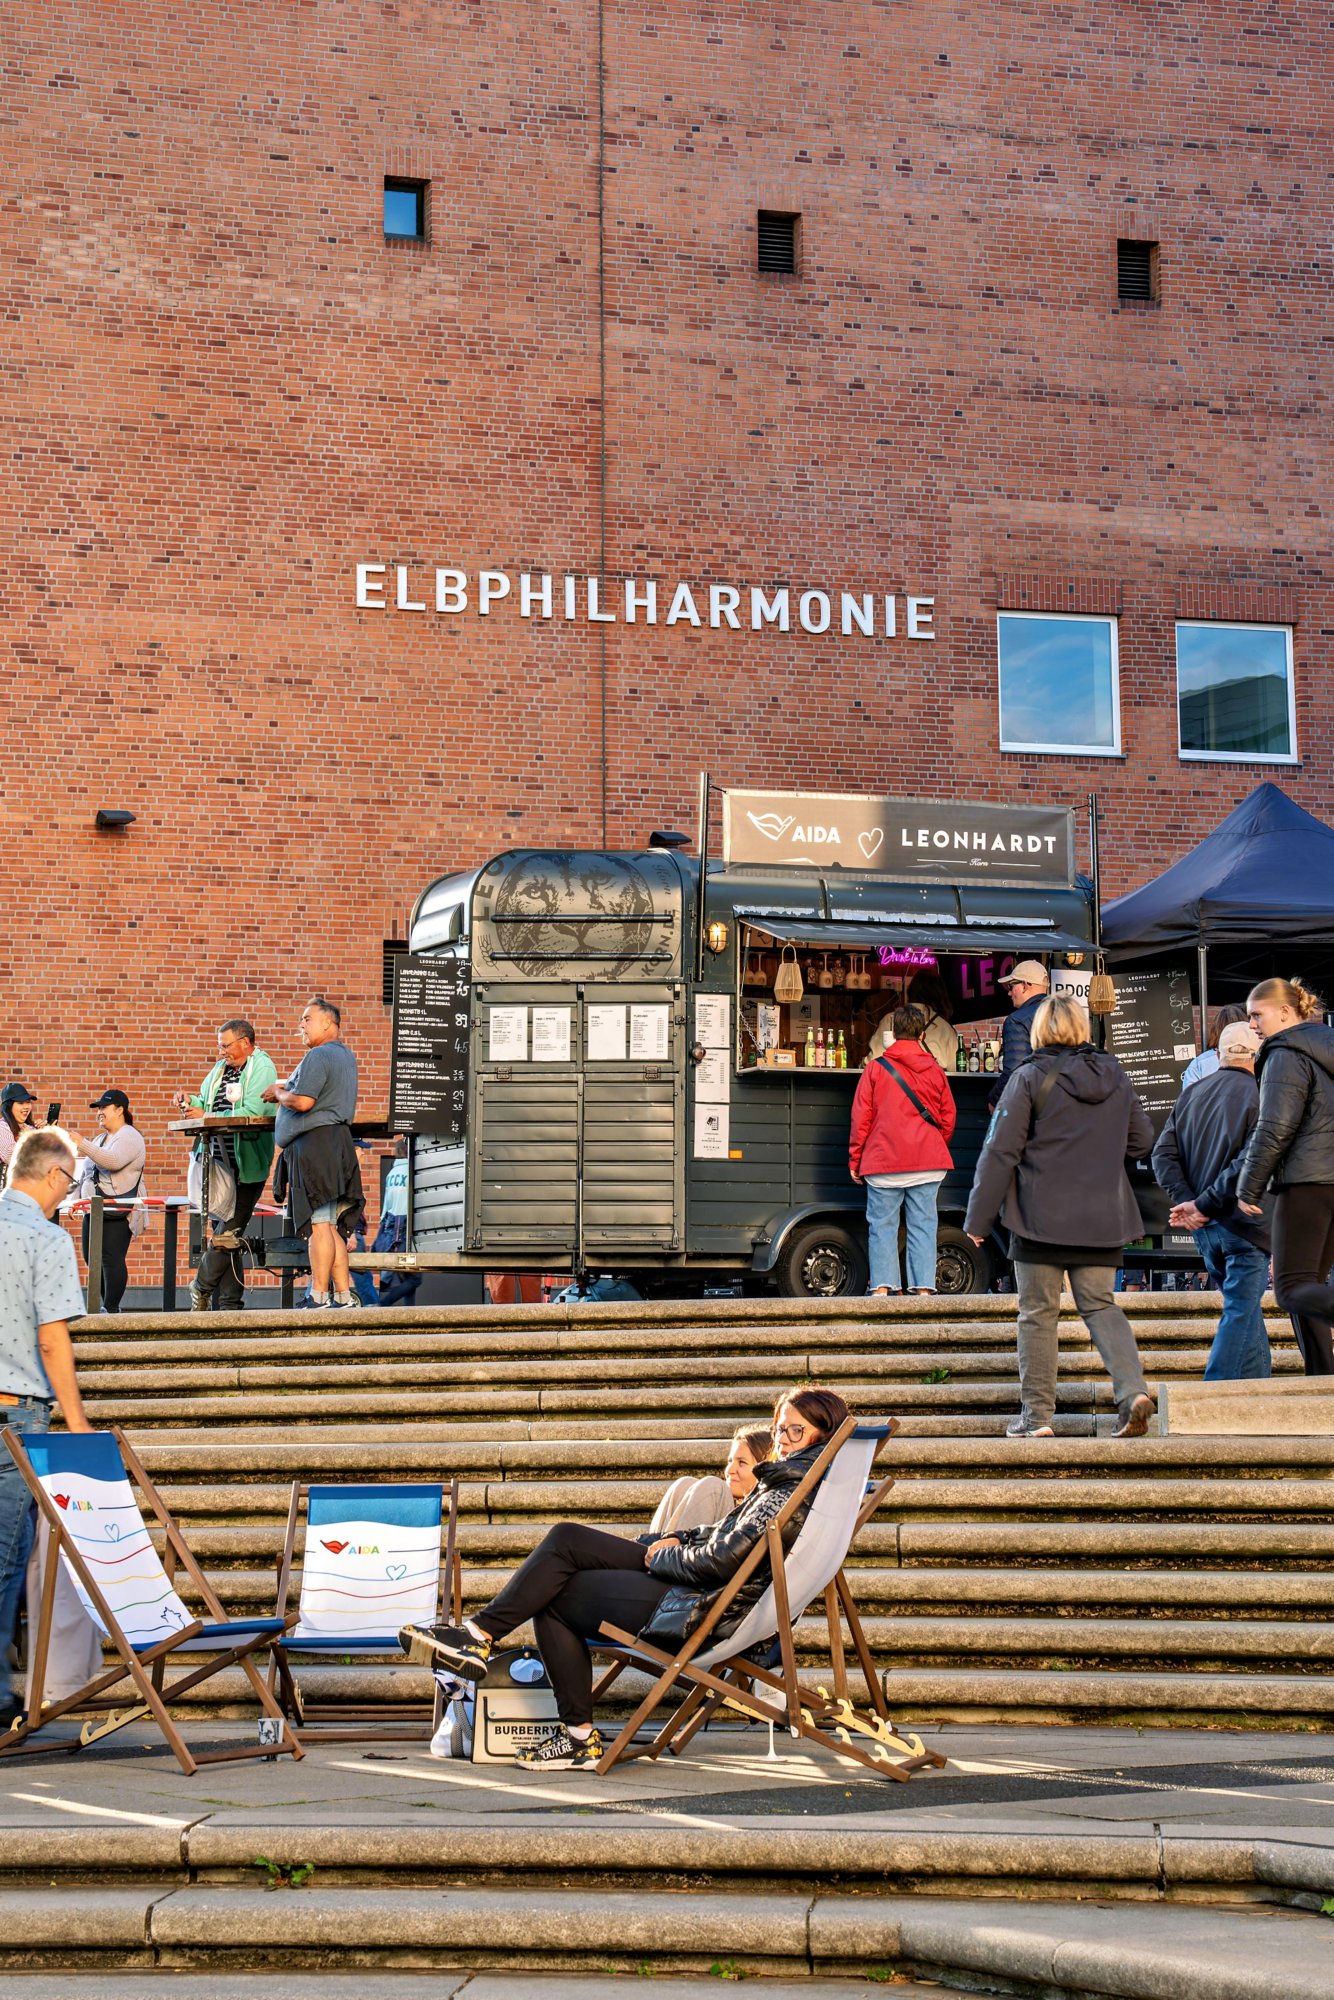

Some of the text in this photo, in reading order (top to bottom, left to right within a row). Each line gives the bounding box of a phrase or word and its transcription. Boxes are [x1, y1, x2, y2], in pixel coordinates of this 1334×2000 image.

[356, 563, 936, 640] ELBPHILHARMONIE
[791, 825, 841, 844] AIDA
[901, 828, 1057, 854] LEONHARDT
[72, 1501, 94, 1511] AIDA
[348, 1546, 380, 1555] AIDA
[494, 1725, 559, 1736] BURBERRY
